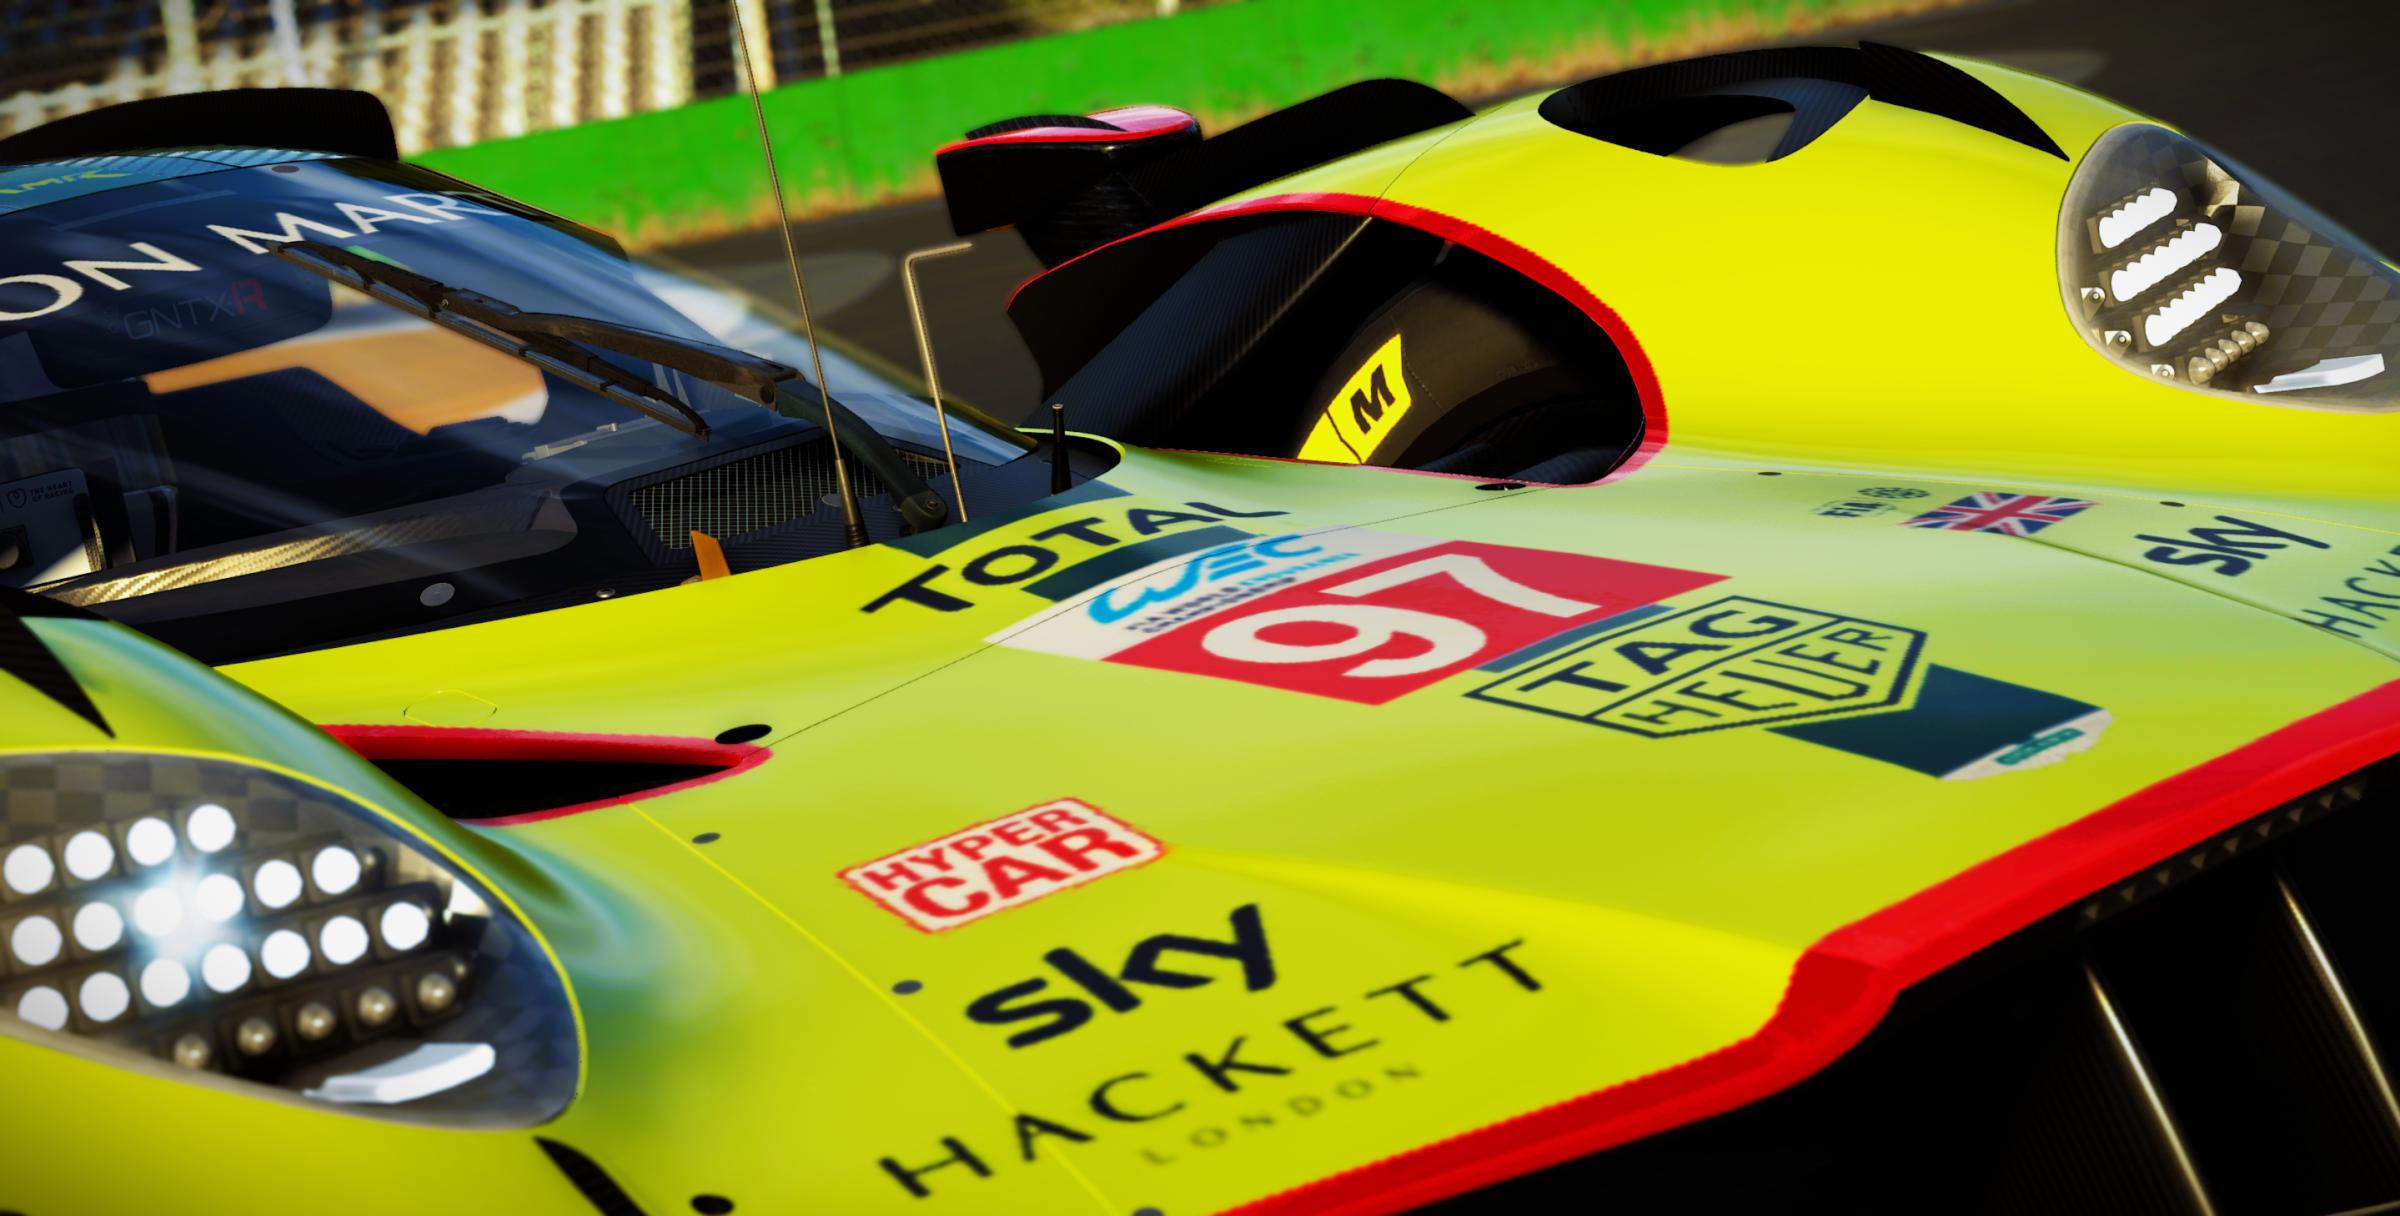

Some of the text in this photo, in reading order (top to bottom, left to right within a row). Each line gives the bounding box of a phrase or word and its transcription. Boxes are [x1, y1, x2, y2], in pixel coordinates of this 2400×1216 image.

[1349, 363, 1396, 435] M
[860, 501, 1291, 614] TOTAL
[1087, 533, 1324, 625] WEC
[2133, 514, 2332, 577] sky
[2300, 545, 2400, 638] HACK
[1201, 553, 1603, 678] 97
[1516, 610, 1800, 694] TAG
[1621, 626, 1894, 725] HEUER
[860, 807, 1089, 891] HYPER
[902, 827, 1141, 919] CAR
[964, 902, 1278, 1050] sky
[877, 938, 1543, 1199] HACKETT
[1139, 1063, 1422, 1165] LONDON
